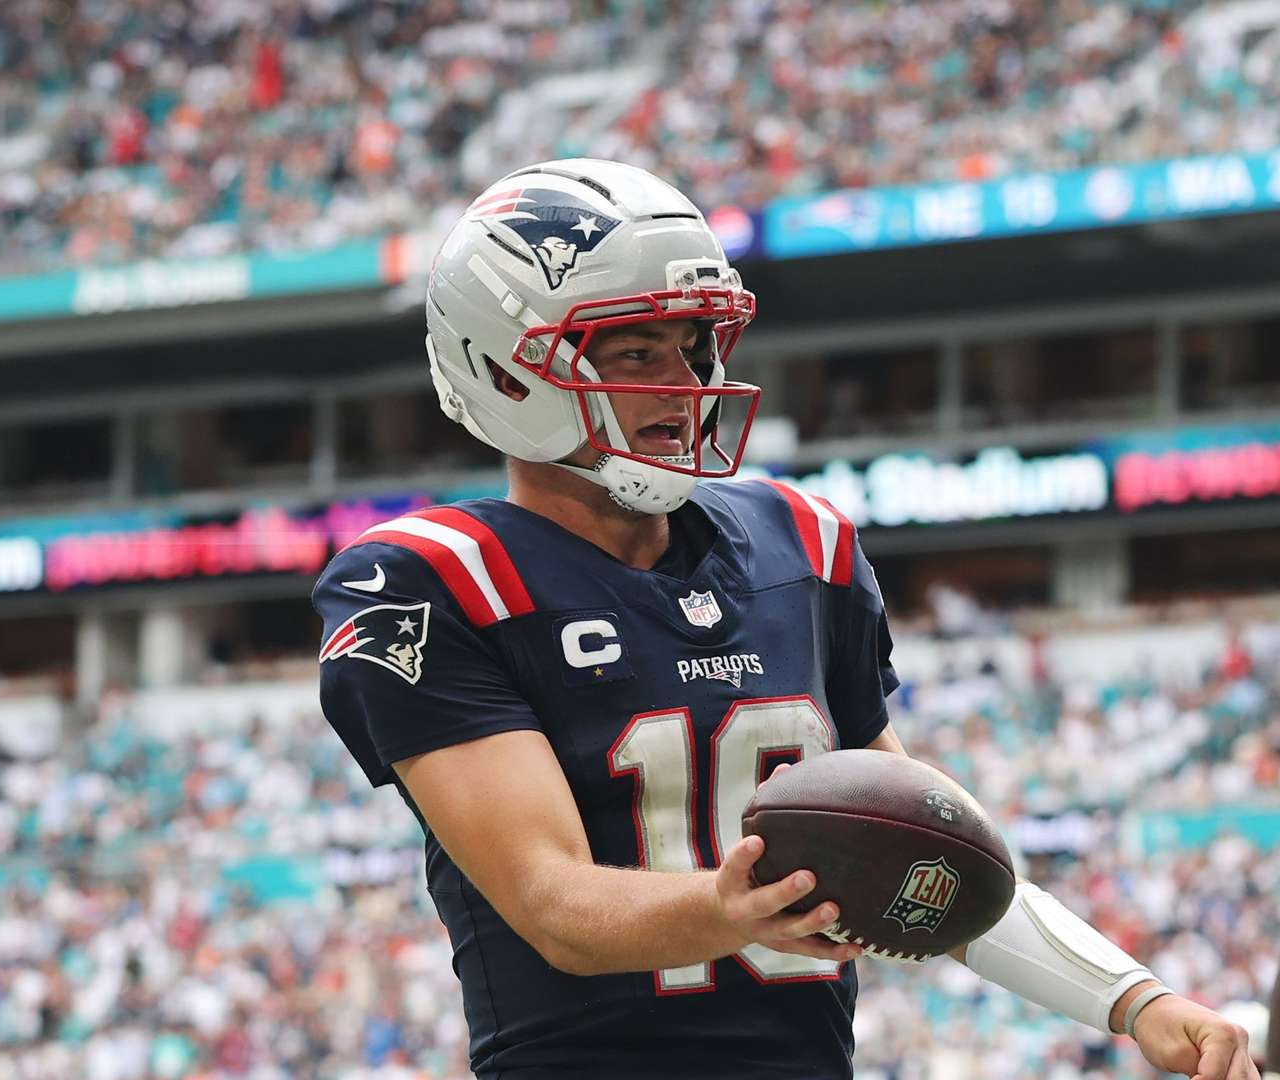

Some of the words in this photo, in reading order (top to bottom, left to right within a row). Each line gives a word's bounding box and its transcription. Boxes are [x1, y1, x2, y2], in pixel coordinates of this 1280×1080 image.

[865, 446, 1108, 527] Stadium
[690, 603, 718, 623] NFL
[560, 618, 622, 669] C
[676, 653, 765, 684] PATRIOTS
[912, 865, 956, 912] NFL
